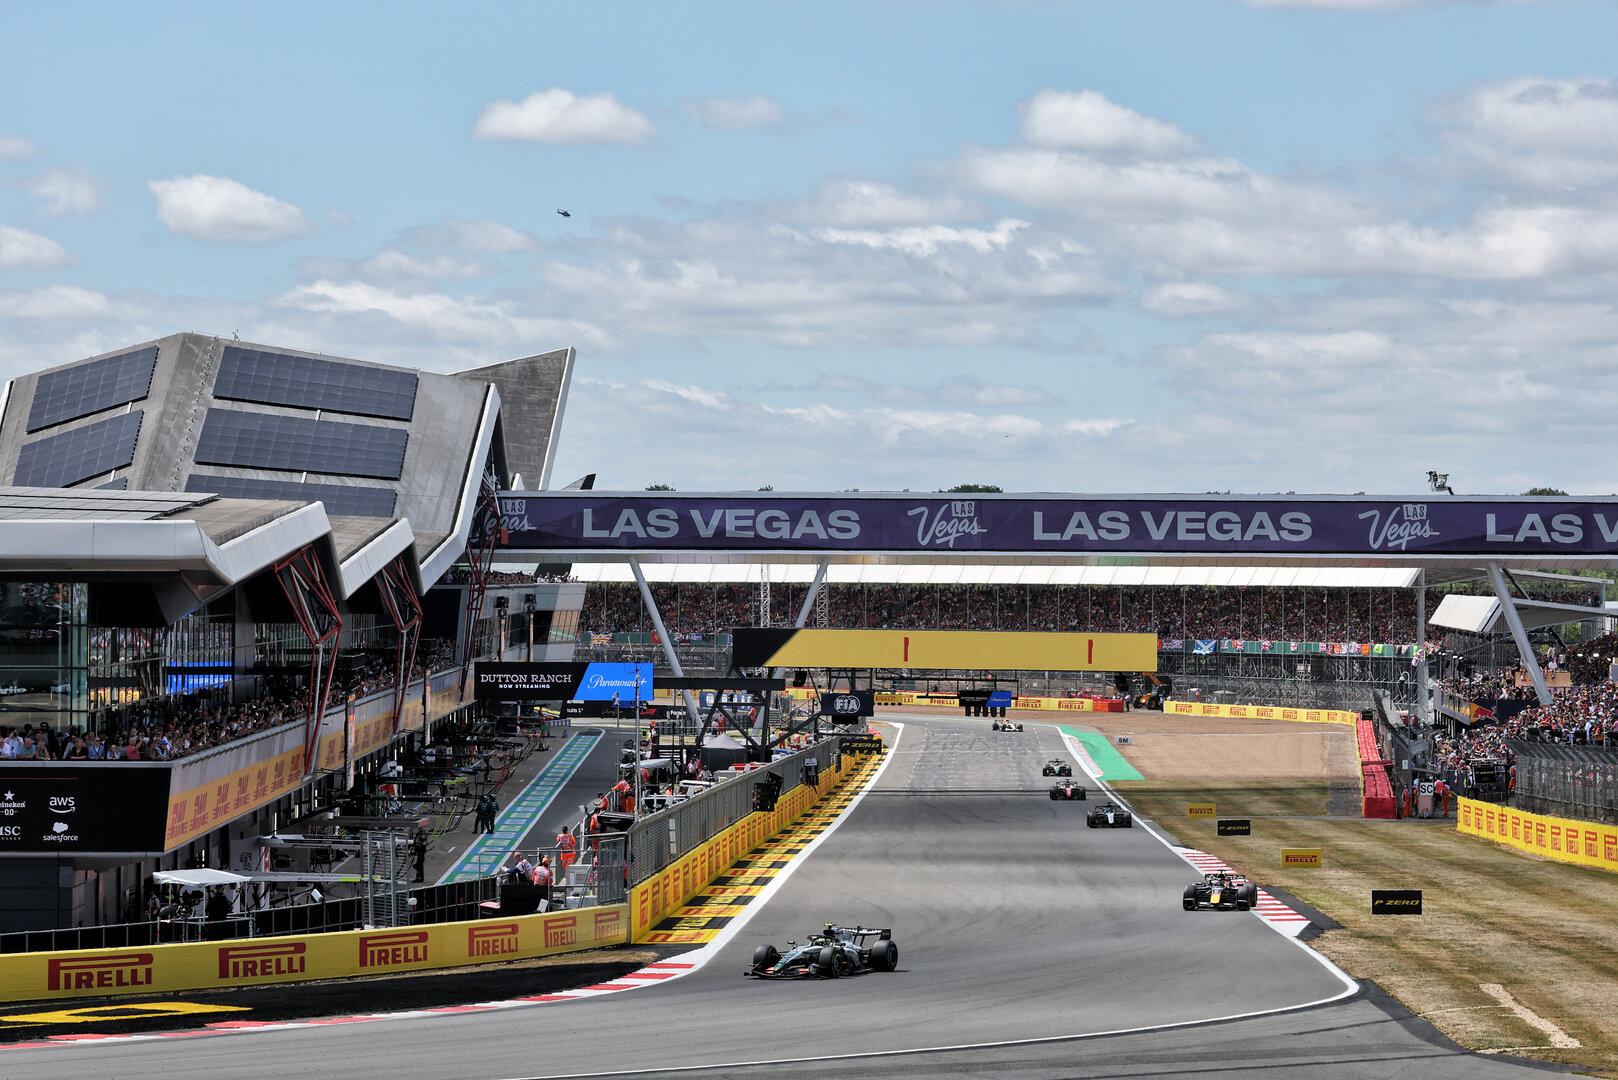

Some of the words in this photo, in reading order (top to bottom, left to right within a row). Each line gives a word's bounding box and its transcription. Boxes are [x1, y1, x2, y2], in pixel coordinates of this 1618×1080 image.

[505, 501, 524, 513] LAS
[954, 503, 973, 516] LAS
[1405, 505, 1425, 518] LAS
[583, 508, 680, 539] LAS
[689, 509, 861, 540] VEGAS
[907, 503, 988, 548] Vegas
[1033, 511, 1131, 541] LAS
[1140, 511, 1313, 542] VEGAS
[1358, 506, 1440, 551] Vegas
[1486, 513, 1583, 544] LAS
[480, 674, 528, 683] DUTTON
[531, 674, 572, 683] RANCH
[835, 698, 859, 711] FIA
[1015, 699, 1041, 709] PIRELLI
[1058, 700, 1084, 710] PIRELLI
[1420, 784, 1433, 794] SC
[49, 796, 75, 807] aws
[43, 833, 79, 842] salesforce
[1285, 855, 1318, 863] PIRELLI
[543, 915, 577, 948] PIRELLI
[594, 910, 620, 941] PIRELLI
[359, 931, 429, 967] PIRELLI
[467, 923, 519, 957] PIRELLI
[218, 942, 307, 978] PIRELLI
[48, 953, 154, 990] PIRELLI
